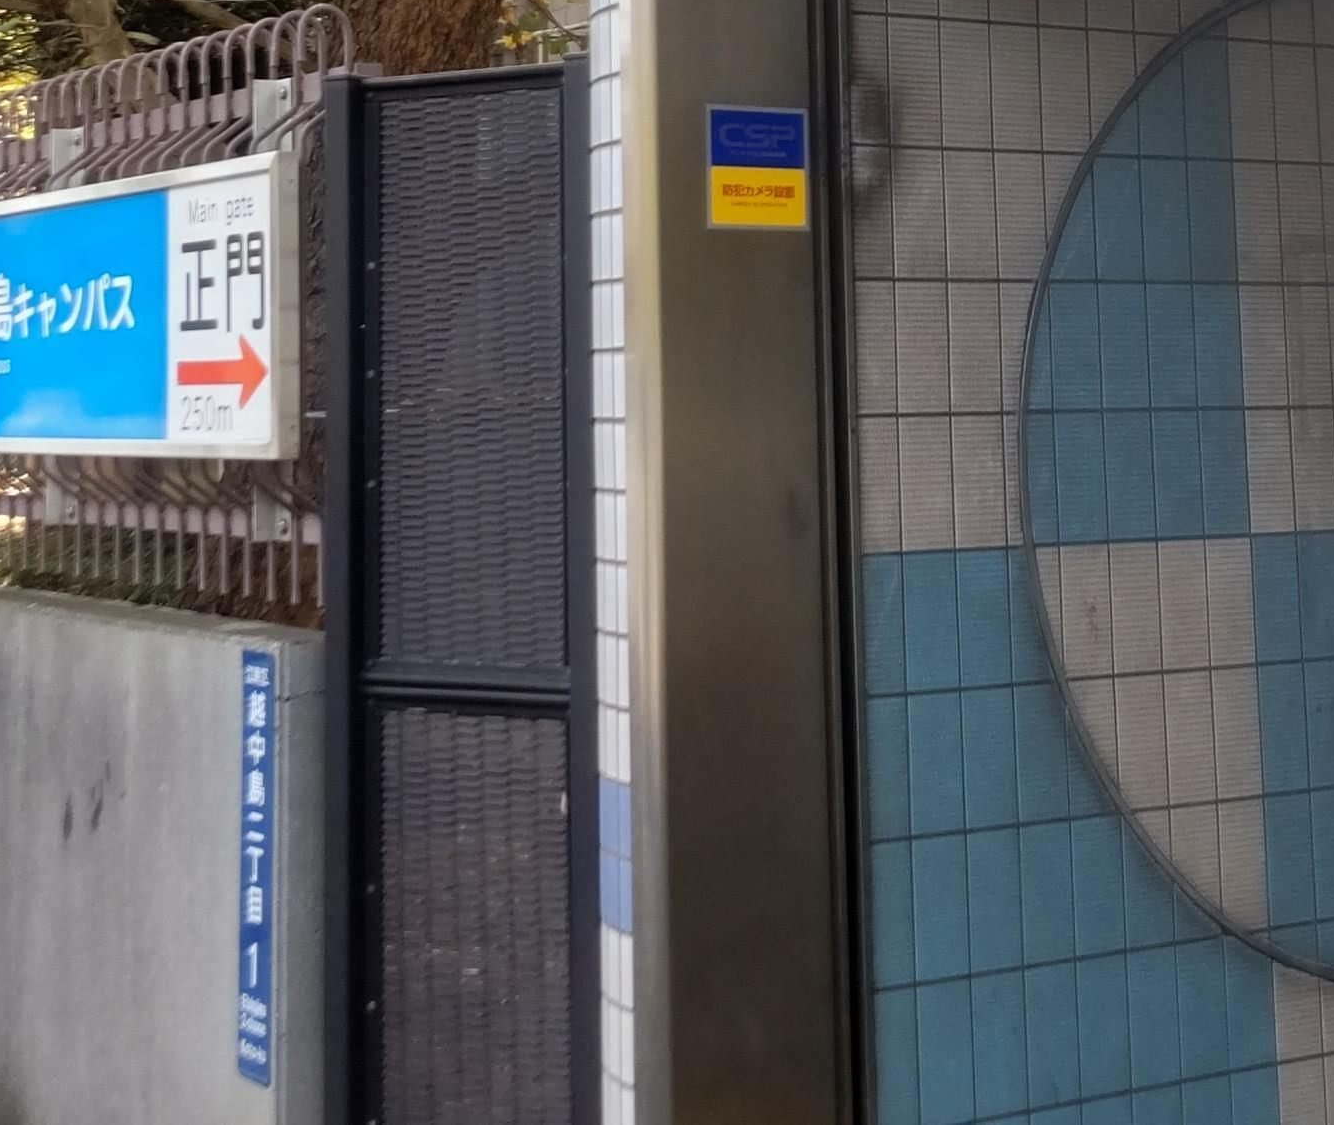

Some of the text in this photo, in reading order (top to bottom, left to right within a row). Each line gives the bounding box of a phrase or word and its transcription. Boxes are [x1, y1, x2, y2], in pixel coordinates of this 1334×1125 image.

[719, 122, 796, 149] CSP
[188, 195, 255, 226] Main gate
[179, 230, 266, 333] 正門
[179, 395, 235, 431] 250m
